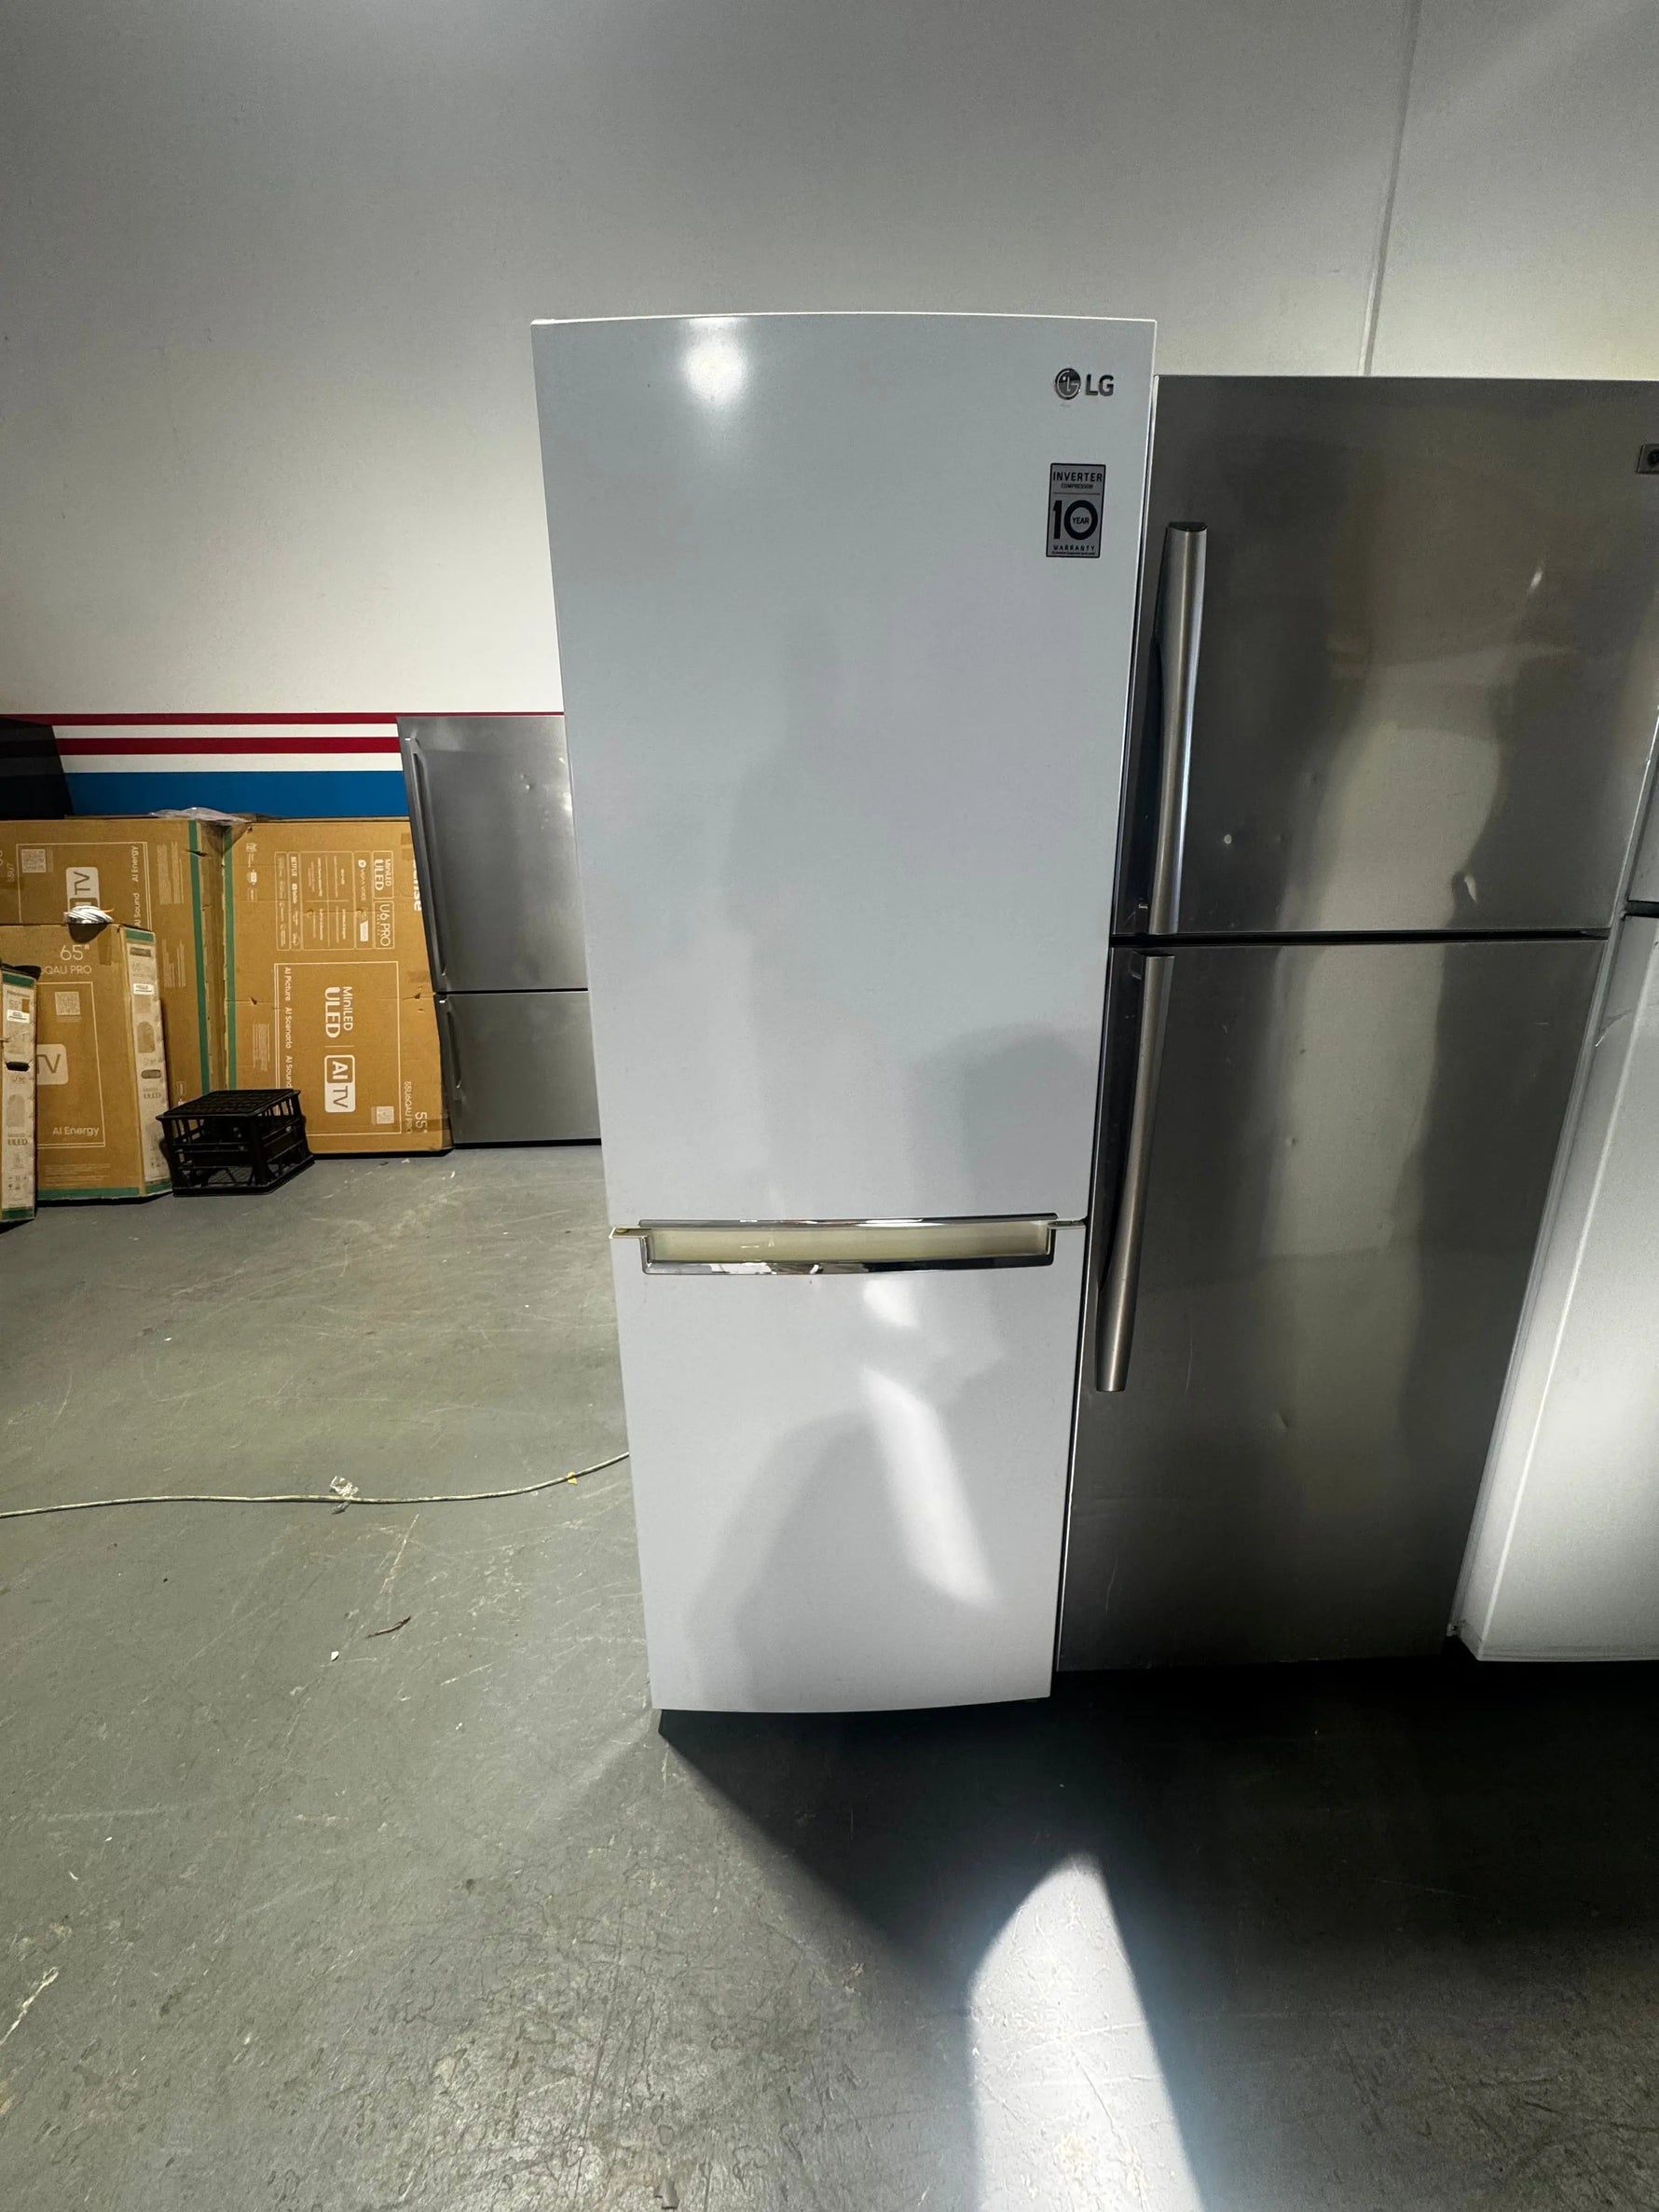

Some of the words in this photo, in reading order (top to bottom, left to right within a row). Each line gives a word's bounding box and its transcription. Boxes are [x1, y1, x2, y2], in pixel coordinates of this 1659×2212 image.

[1085, 374, 1115, 396] LG
[1053, 471, 1103, 482] INVERTER
[1052, 500, 1099, 540] 10
[1072, 516, 1090, 525] YEAR
[131, 845, 140, 871] Energy
[73, 871, 90, 895] TV
[131, 872, 139, 882] AI
[374, 859, 384, 891] ULED
[379, 903, 391, 920] U6
[380, 923, 391, 947] PRO
[61, 944, 89, 960] 65"
[70, 965, 92, 974] PRO
[284, 967, 291, 975] AI
[285, 1007, 293, 1015] AI
[324, 987, 340, 1038] ULED
[342, 986, 353, 1031] MiniLED
[332, 1060, 349, 1080] AI
[333, 1086, 349, 1108] TV
[52, 1127, 62, 1135] AI
[64, 1126, 100, 1137] Energy
